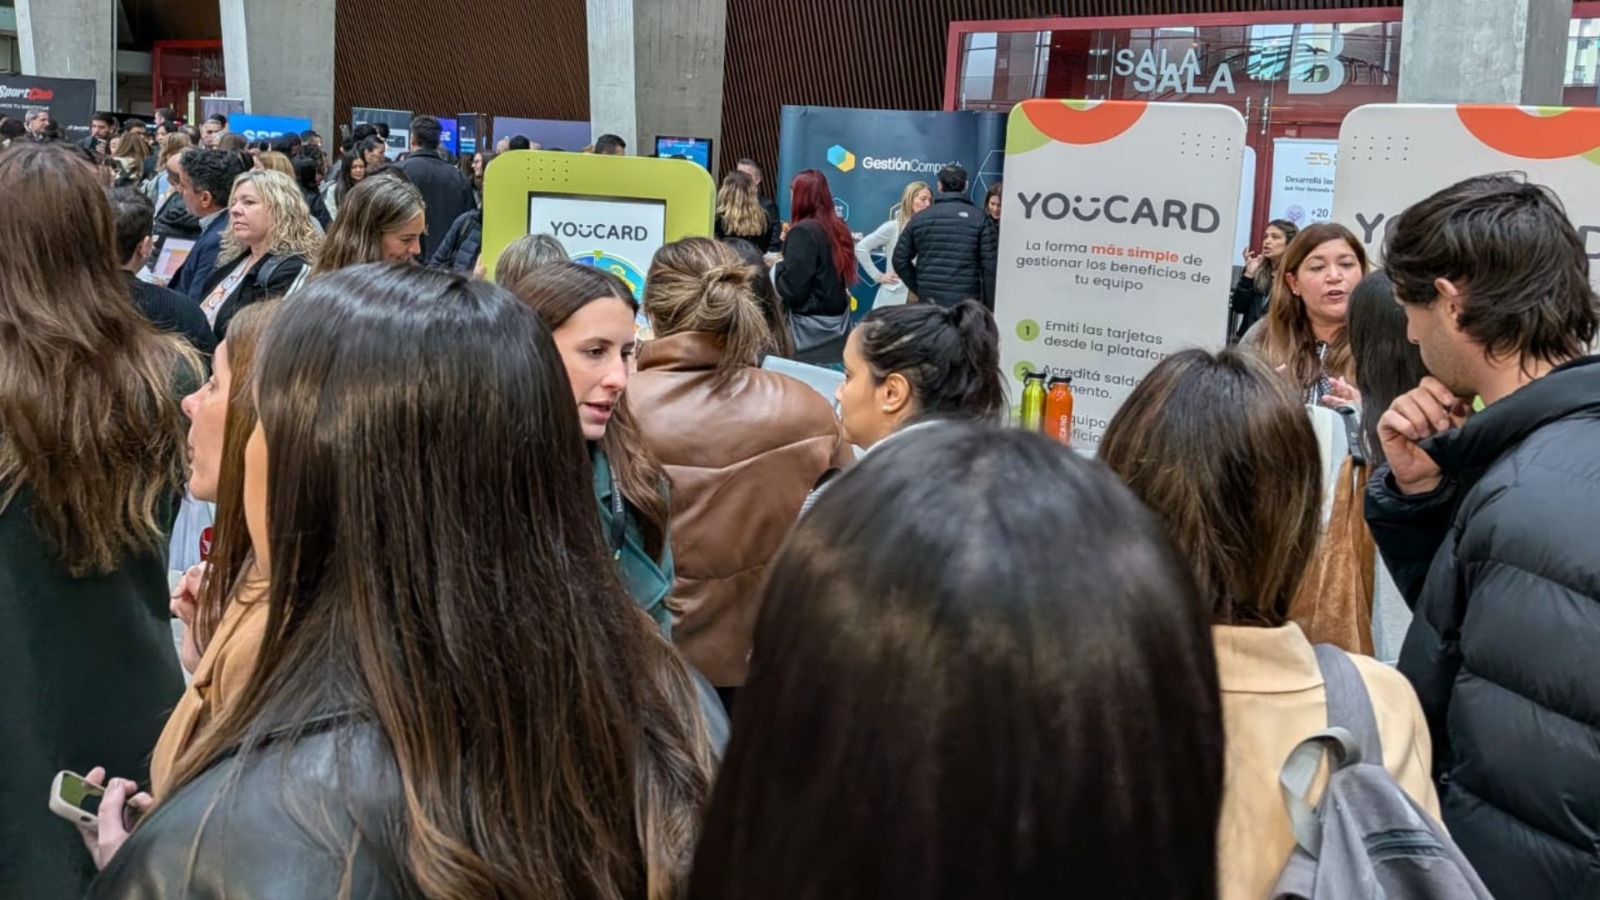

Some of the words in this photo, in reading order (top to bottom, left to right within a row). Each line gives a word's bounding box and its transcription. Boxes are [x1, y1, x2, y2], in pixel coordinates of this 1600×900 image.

[1133, 62, 1236, 94] SALA
[1288, 30, 1344, 94] B
[1311, 208, 1329, 218] +20
[1025, 241, 1041, 251] La
[1045, 240, 1087, 254] forma
[1091, 242, 1123, 256] más
[1127, 246, 1179, 264] simple
[1183, 252, 1203, 266] de
[1016, 255, 1082, 268] gestionar
[1086, 258, 1107, 271] los
[1110, 262, 1187, 281] beneficios
[1191, 271, 1211, 284] de
[1075, 274, 1089, 285] tu
[1093, 275, 1143, 292] equipo
[1045, 321, 1079, 334] Emití
[1083, 323, 1103, 337] las
[1107, 327, 1163, 345] tarjetas
[1044, 336, 1087, 350] desde
[1091, 340, 1103, 352] la
[1107, 344, 1168, 361] platafor
[1043, 365, 1100, 381] Acreditá
